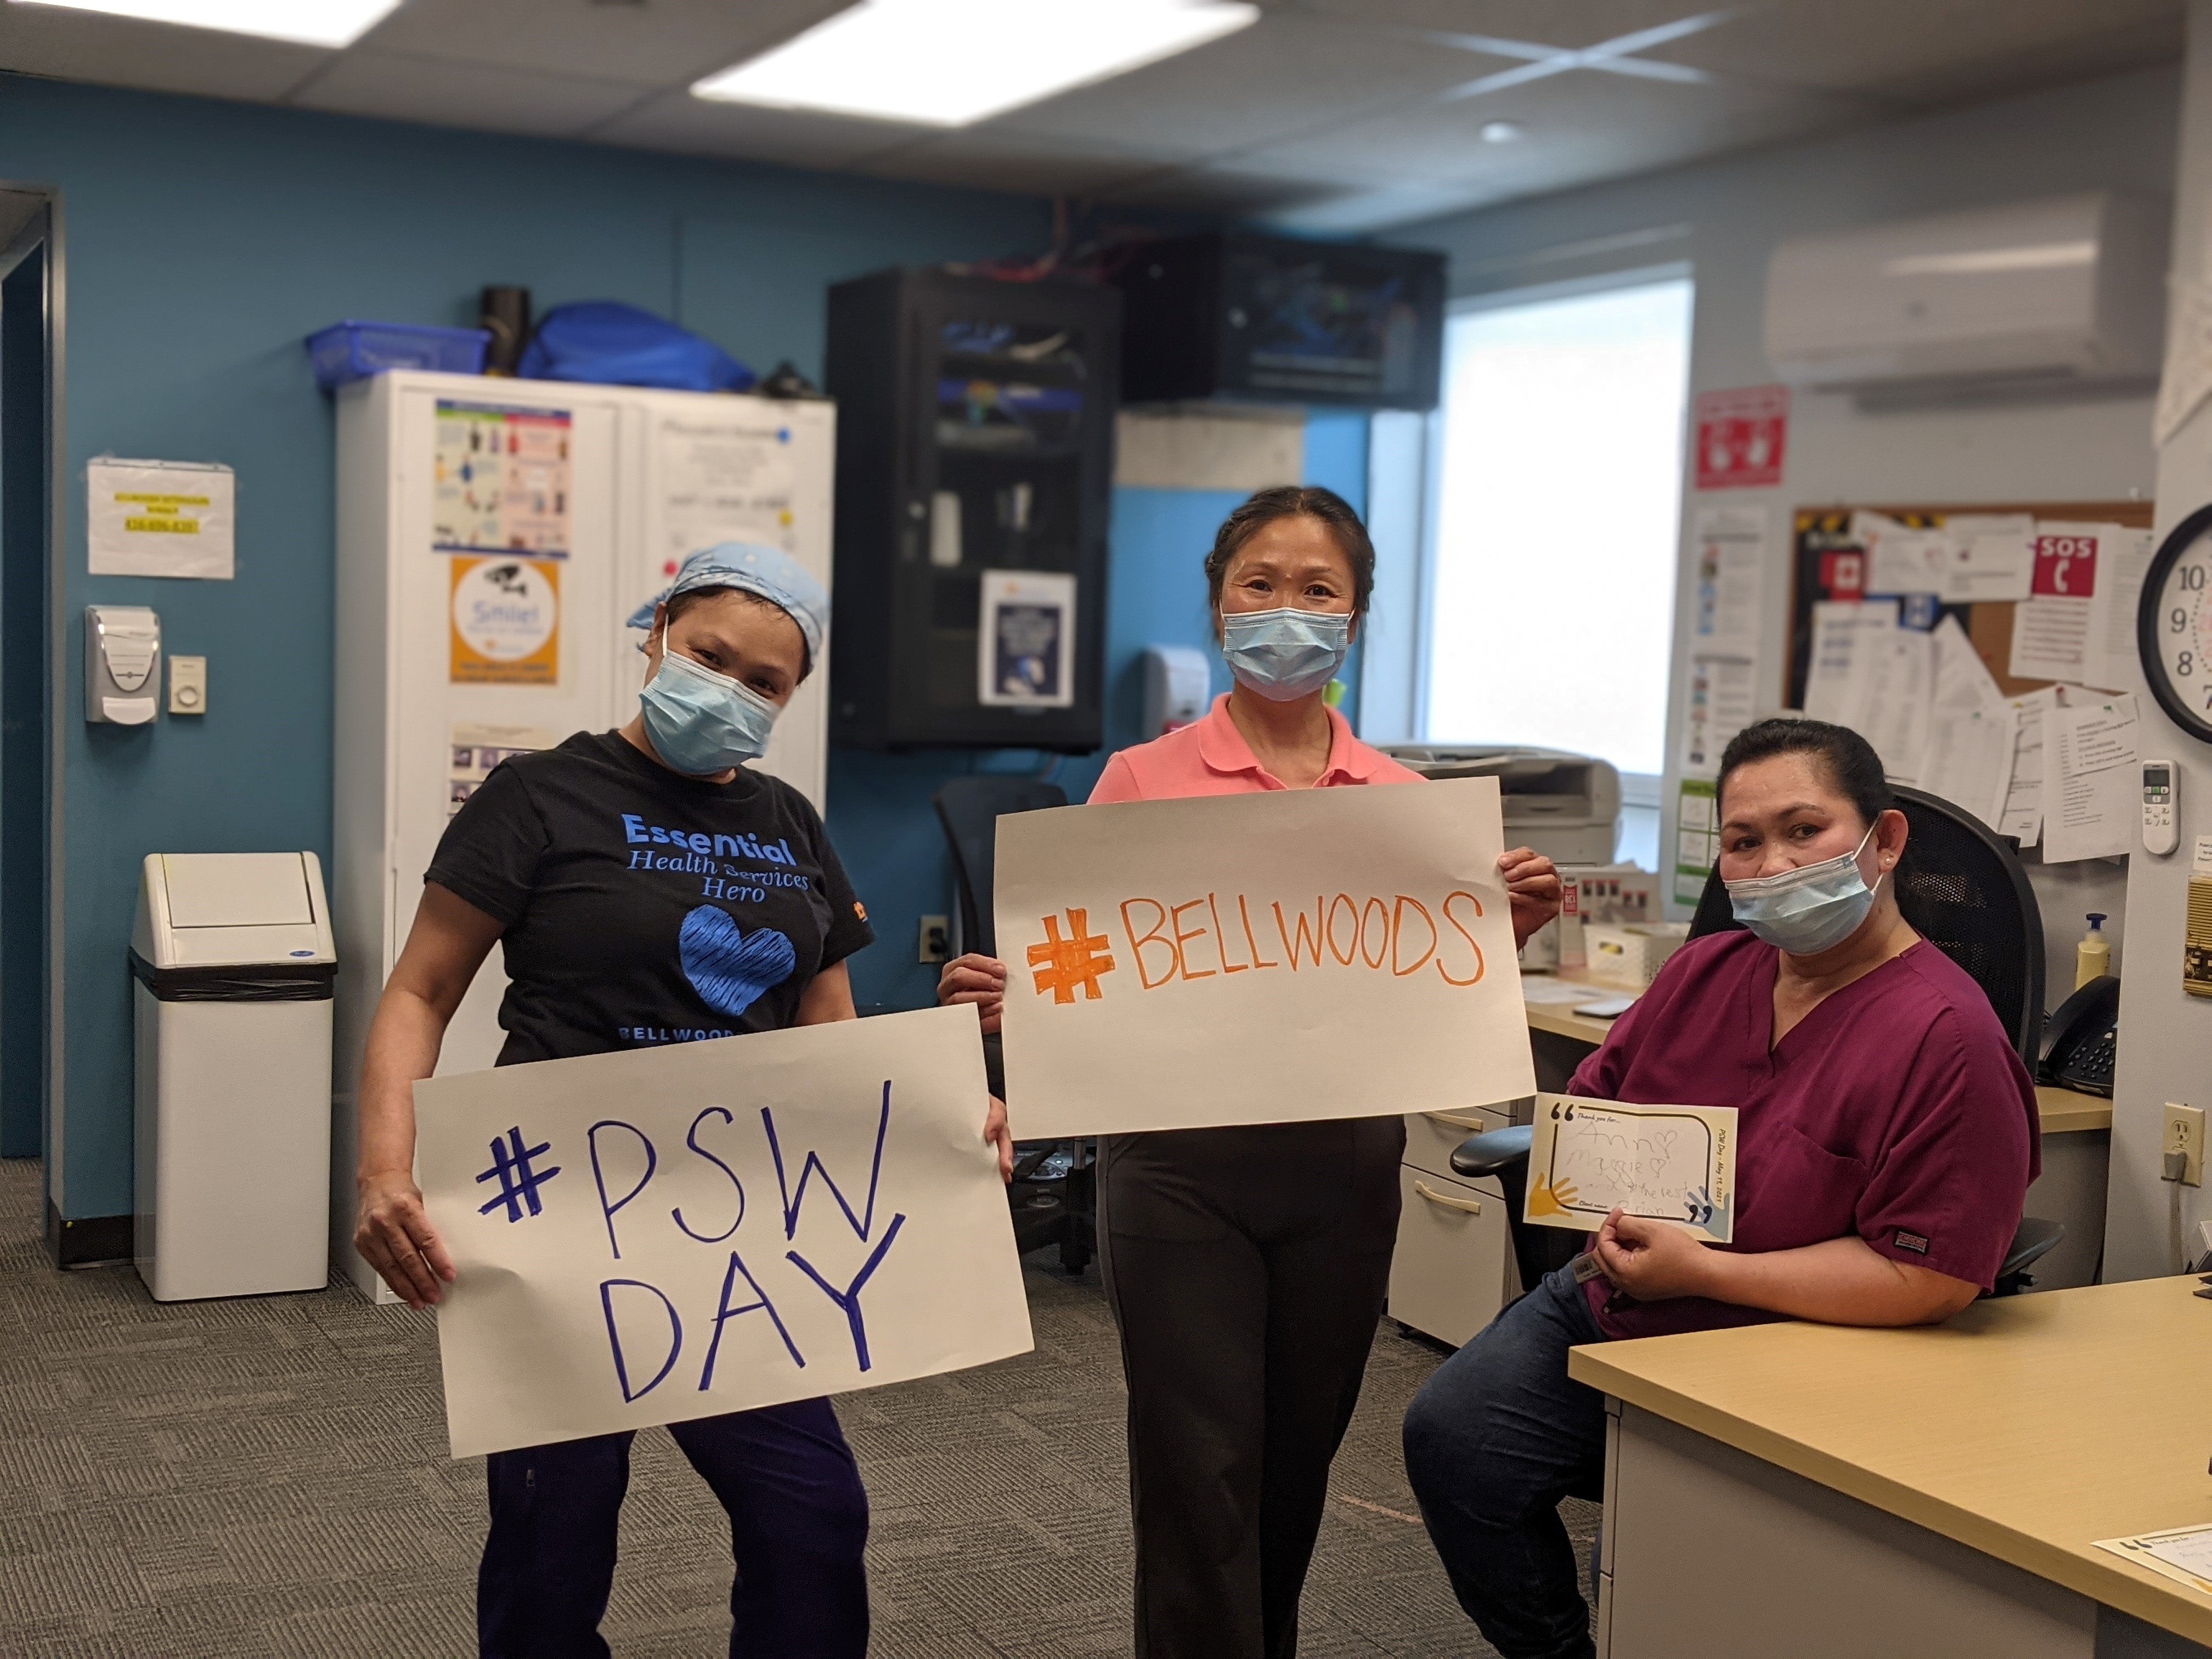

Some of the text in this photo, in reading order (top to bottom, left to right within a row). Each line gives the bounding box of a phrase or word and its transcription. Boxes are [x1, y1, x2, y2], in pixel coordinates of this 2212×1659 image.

[2040, 539, 2091, 558] SOS
[2179, 565, 2205, 591] 10
[2171, 608, 2186, 634] 9
[2177, 651, 2193, 676] 8
[621, 814, 797, 866] Essential
[628, 850, 809, 890] Health Services
[702, 877, 766, 902] Hero
[1026, 890, 1486, 1005] #BELLWOODS
[1717, 1144, 1725, 1156] Day
[476, 1080, 892, 1259] #PSW
[1716, 1161, 1724, 1175] May
[601, 1212, 906, 1403] DAY
